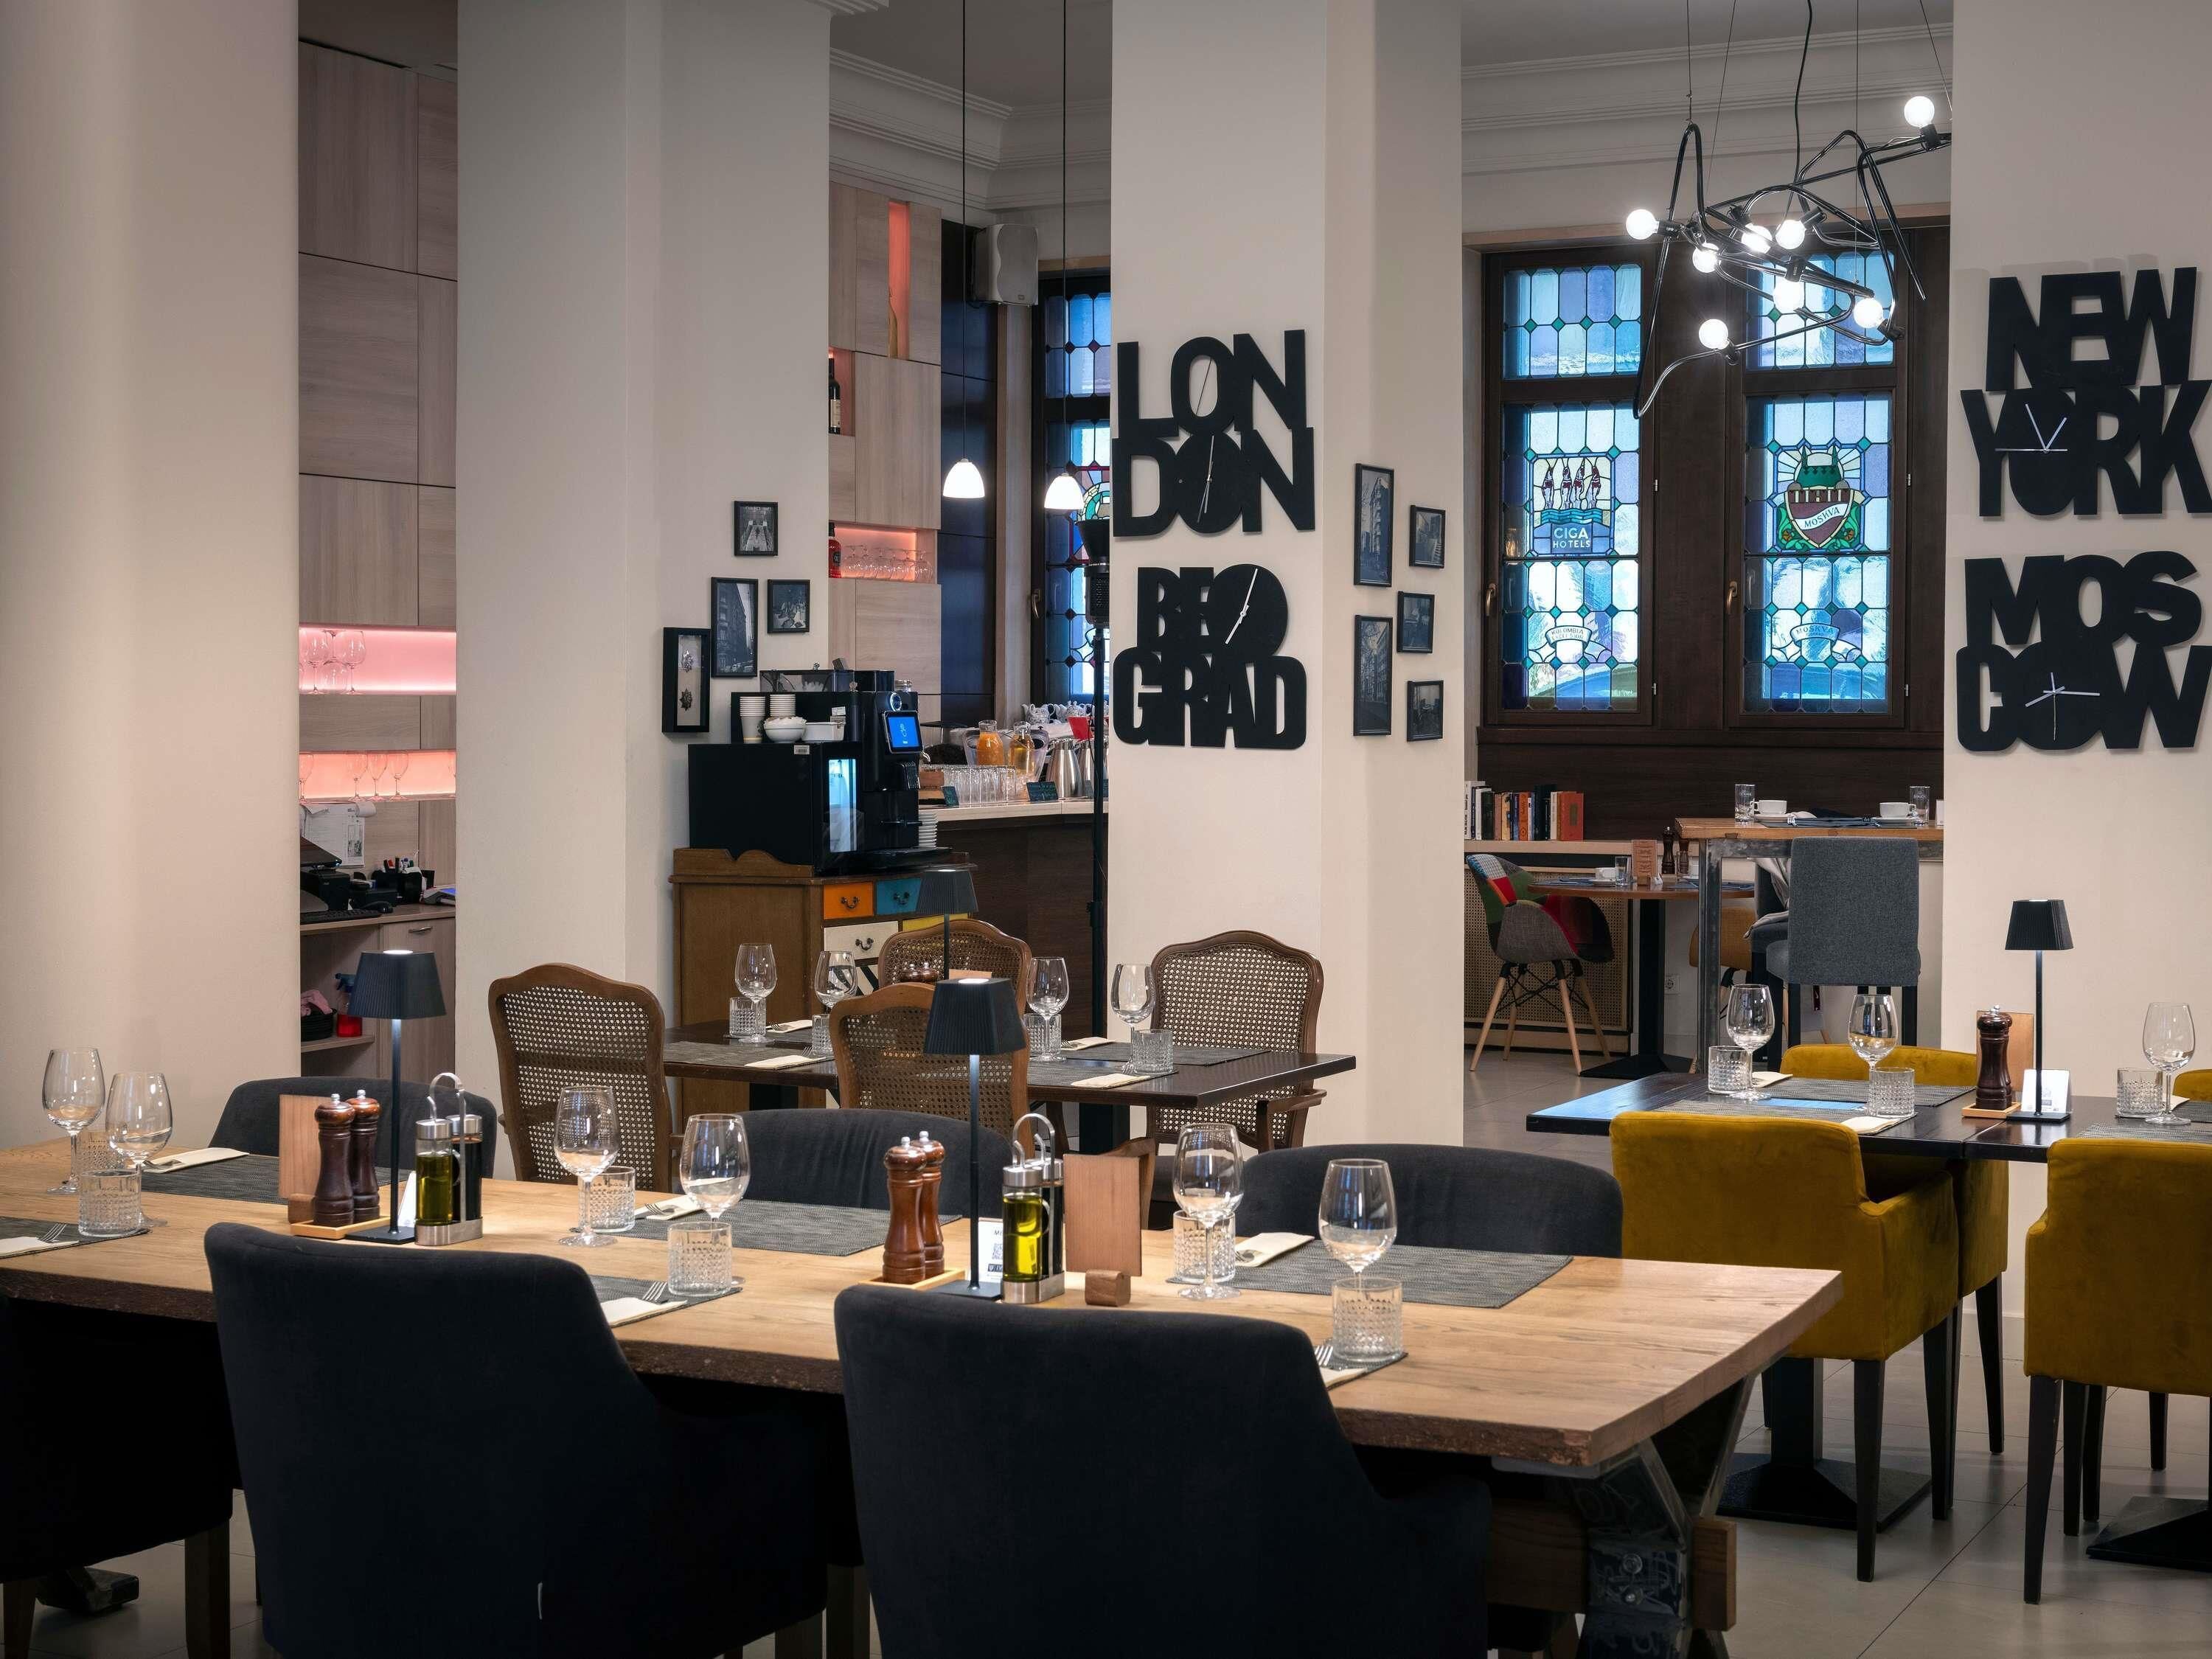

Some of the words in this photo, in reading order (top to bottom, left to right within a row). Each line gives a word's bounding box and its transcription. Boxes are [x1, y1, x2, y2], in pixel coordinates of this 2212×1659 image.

[1986, 267, 2197, 392] NEW
[1961, 380, 2212, 516] YORK
[1553, 540, 1590, 548] HOTELS
[1554, 527, 1589, 539] CIGA
[1113, 647, 1307, 749] GRAD
